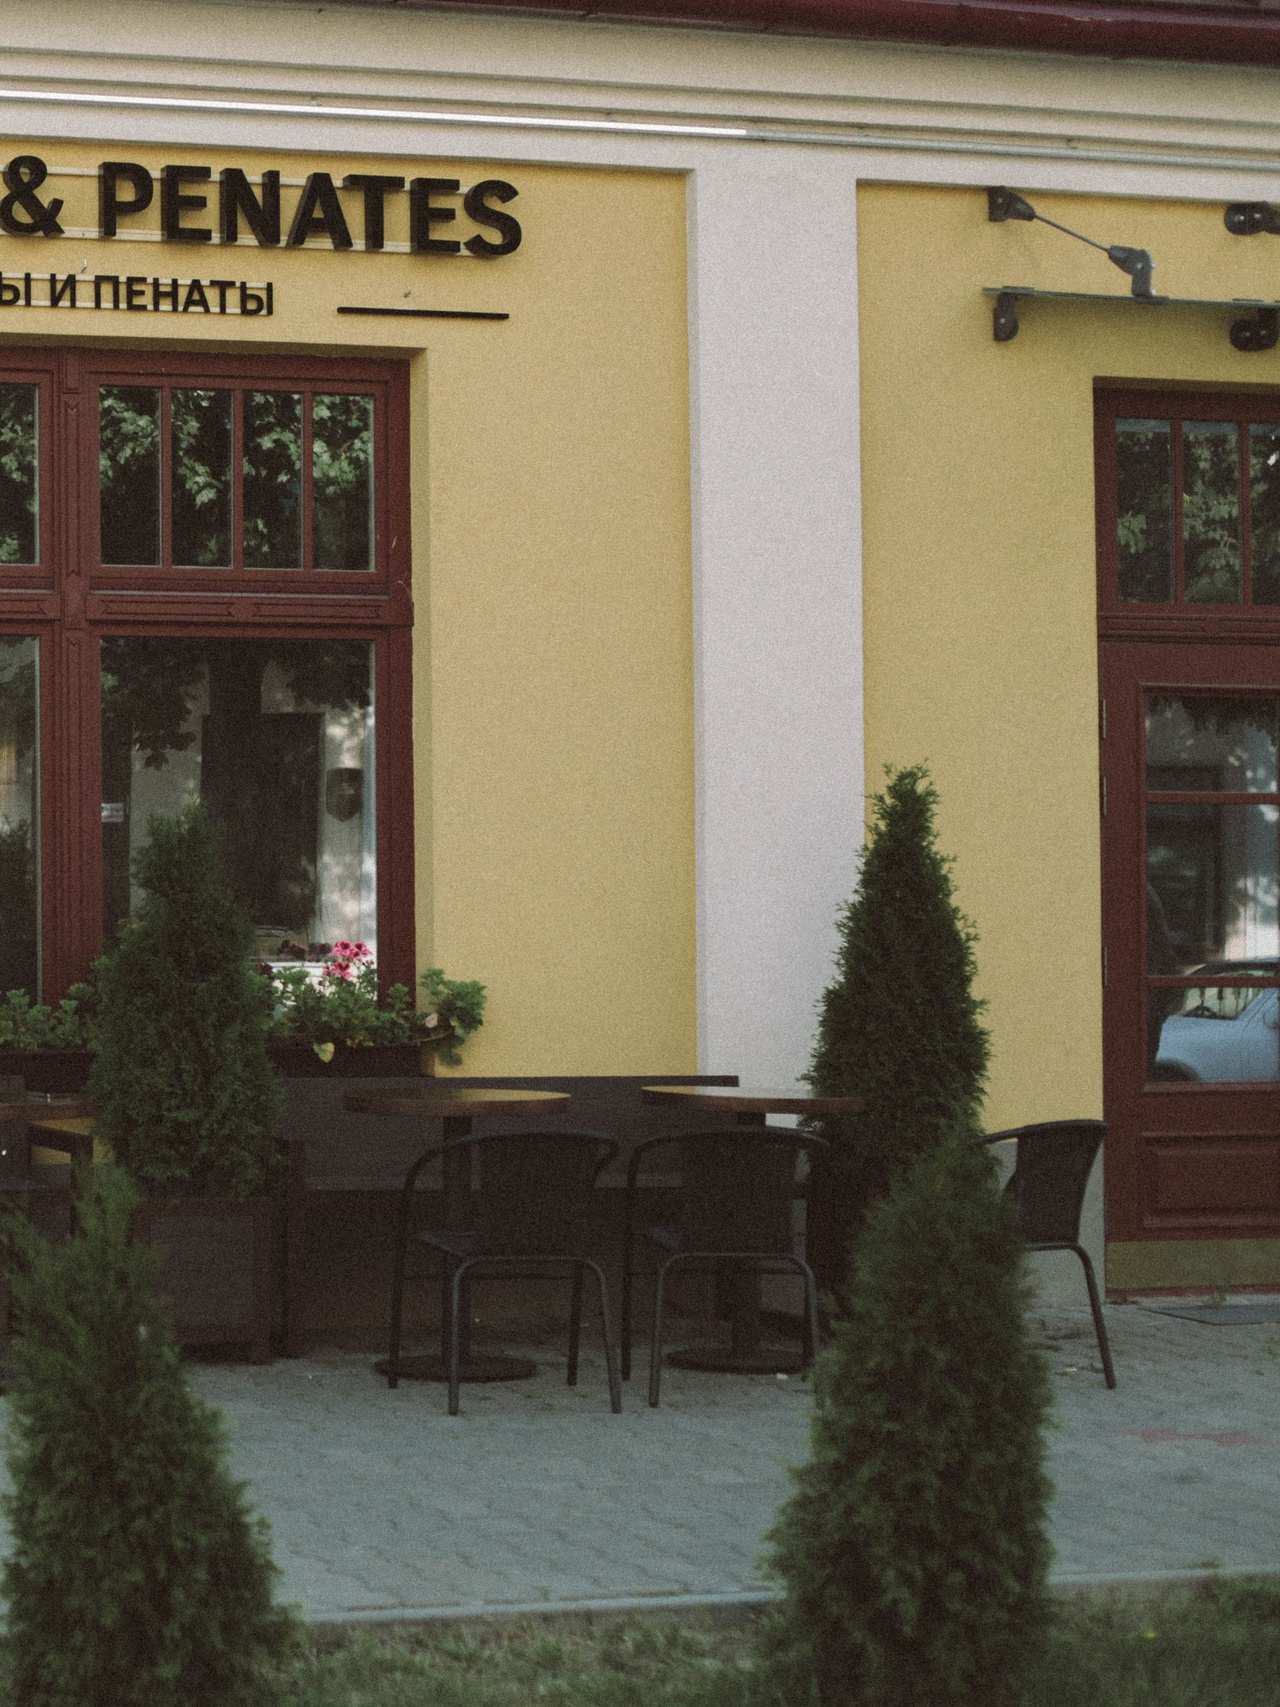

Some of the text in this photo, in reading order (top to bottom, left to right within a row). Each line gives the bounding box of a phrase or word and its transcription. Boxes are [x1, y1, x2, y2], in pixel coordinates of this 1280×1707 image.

[98, 160, 523, 258] PENATES
[49, 272, 77, 309] И
[94, 274, 274, 316] ПЕНАТЫ
